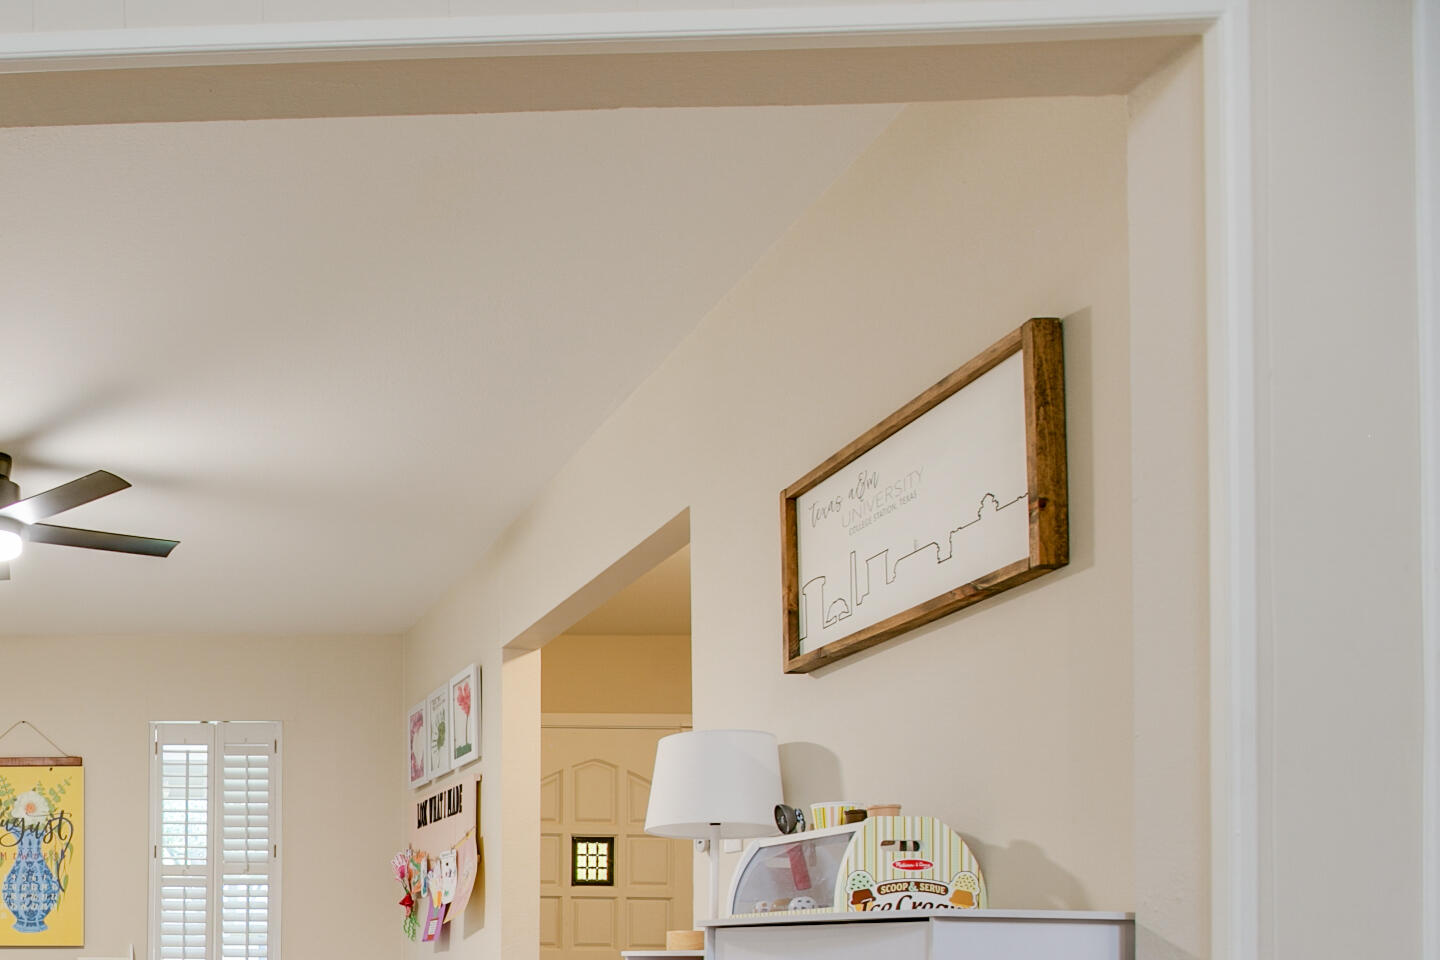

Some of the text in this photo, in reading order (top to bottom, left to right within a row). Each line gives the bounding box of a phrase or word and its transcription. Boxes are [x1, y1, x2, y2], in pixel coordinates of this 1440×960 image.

[841, 464, 924, 528] UNIVERSITY
[417, 783, 463, 829] LOOK WHAT I MADE
[880, 881, 946, 895] SCOOP & SERVE
